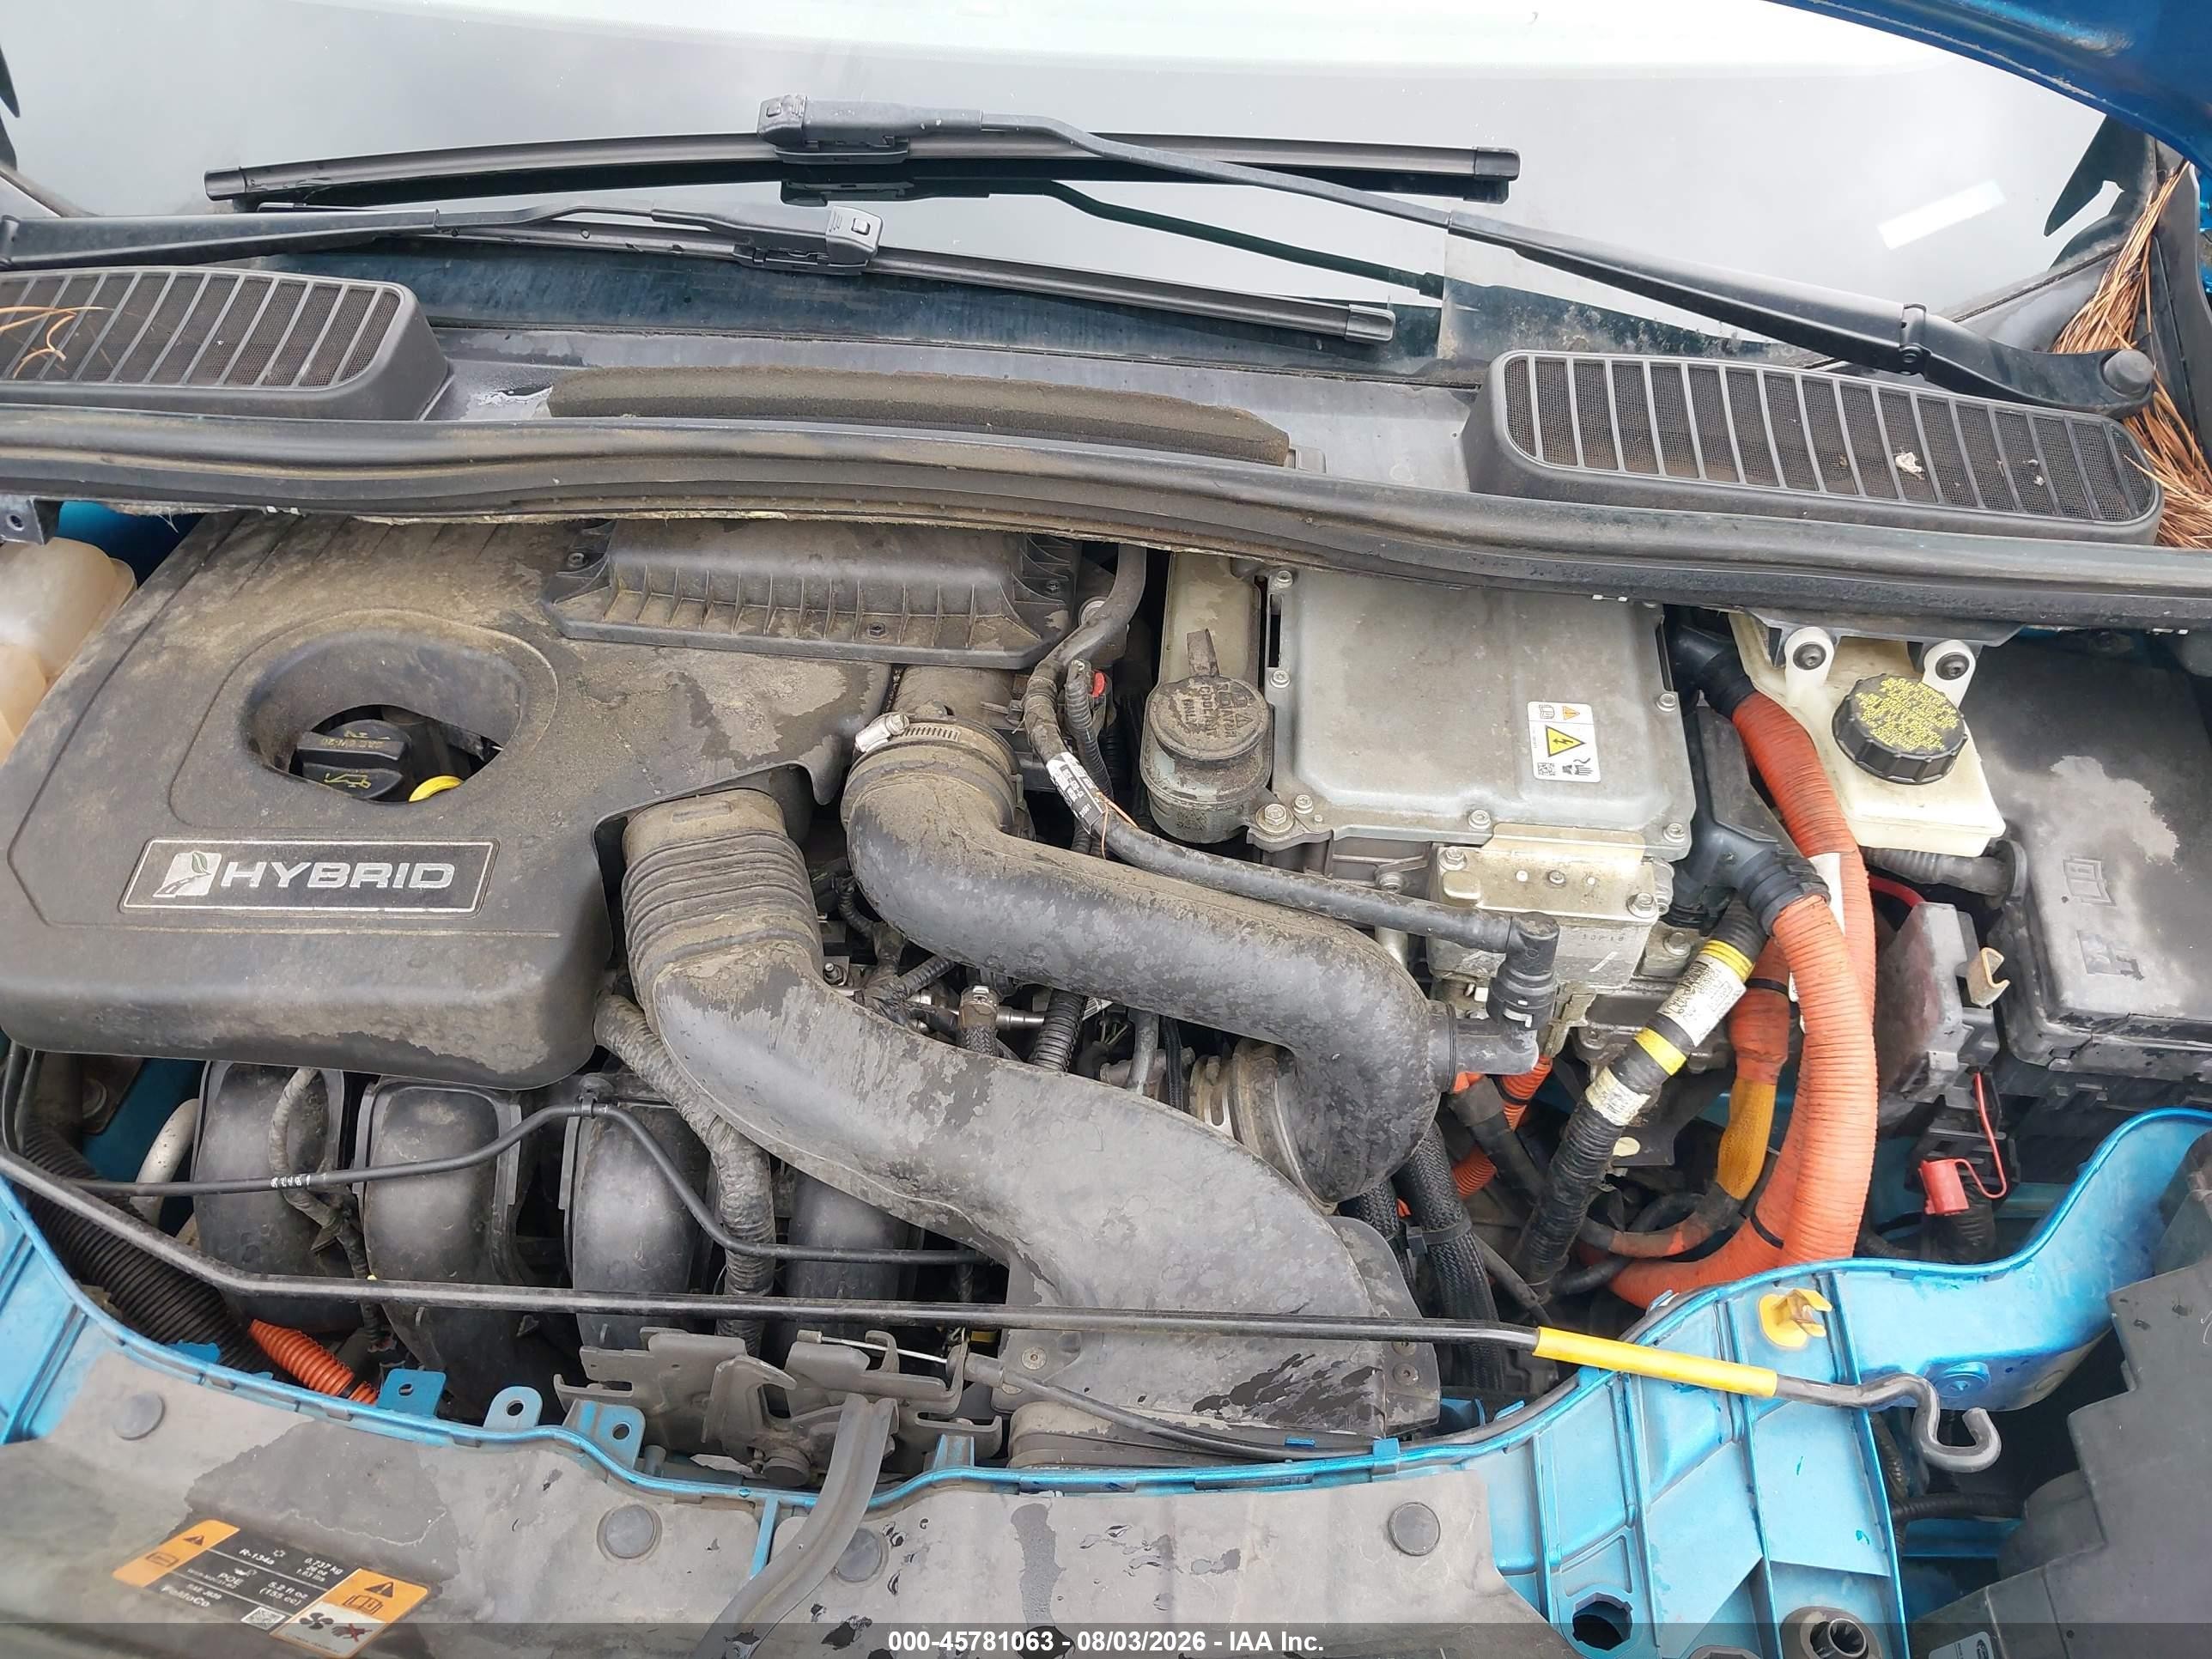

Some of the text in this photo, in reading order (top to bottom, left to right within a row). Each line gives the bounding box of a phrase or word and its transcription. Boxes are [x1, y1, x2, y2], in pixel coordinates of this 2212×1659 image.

[1855, 691, 1878, 708] AVANT
[1880, 679, 1899, 693] ONLY
[1898, 690, 1912, 702] DOT
[1917, 703, 1938, 717] FLUID
[1937, 715, 1958, 729] FROM
[1199, 685, 1218, 737] COOLANT
[1217, 681, 1237, 738] RADIATOR
[1868, 693, 1901, 714] NETTOYER
[1911, 720, 1943, 741] BOUCHON
[1887, 690, 1912, 708] SEALED
[1911, 706, 1948, 730] CONTAINER
[1942, 704, 1957, 715] CAP
[1946, 714, 1960, 724] USE
[1908, 732, 1935, 750] LIQUIDE
[220, 861, 456, 889] HYBRID
[239, 1548, 275, 1565] R-134a
[217, 1572, 244, 1586] POE
[330, 1566, 343, 1575] kg
[268, 1582, 286, 1591] 5.2
[283, 1596, 302, 1606] cc)
